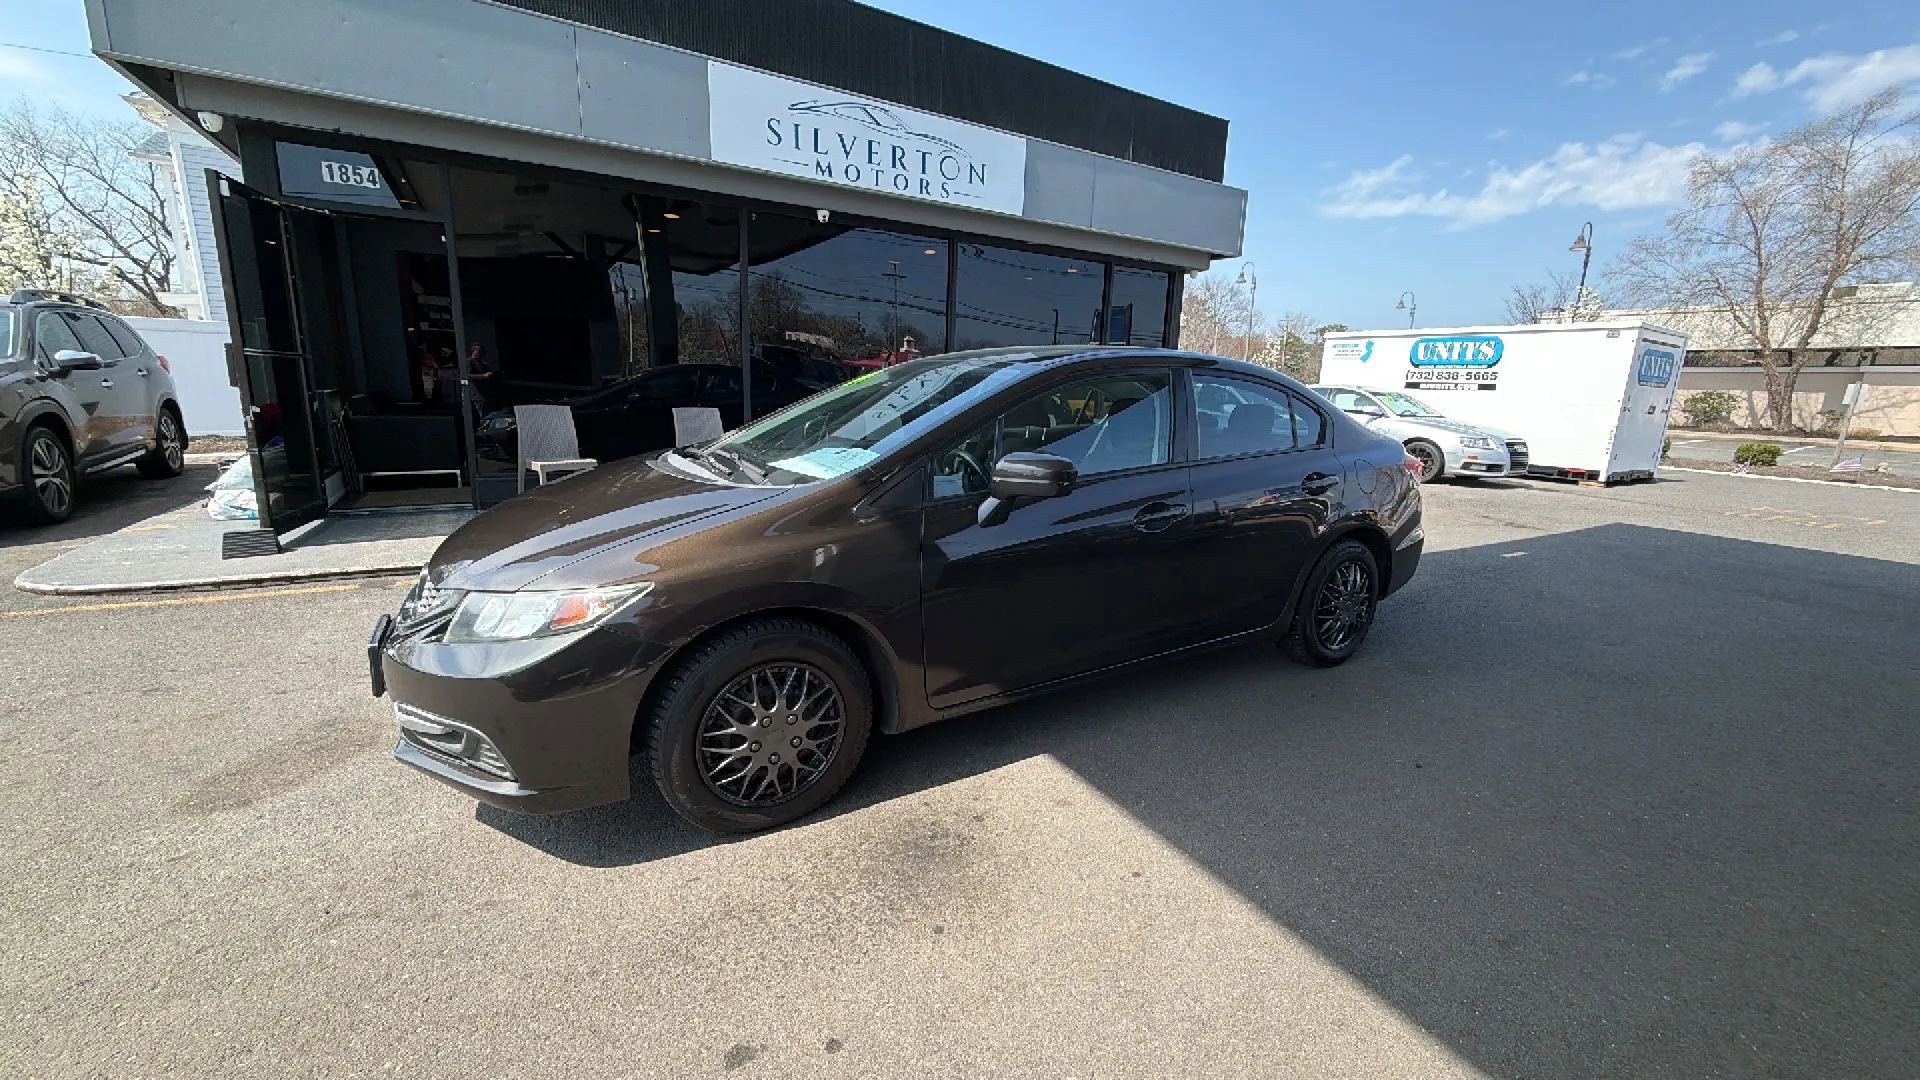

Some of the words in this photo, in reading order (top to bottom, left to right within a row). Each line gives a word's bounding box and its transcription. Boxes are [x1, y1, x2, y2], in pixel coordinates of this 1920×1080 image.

[766, 117, 987, 186] SILVERTON
[325, 163, 378, 187] 1854
[815, 158, 951, 199] MOTORS
[1417, 340, 1497, 361] UNITS
